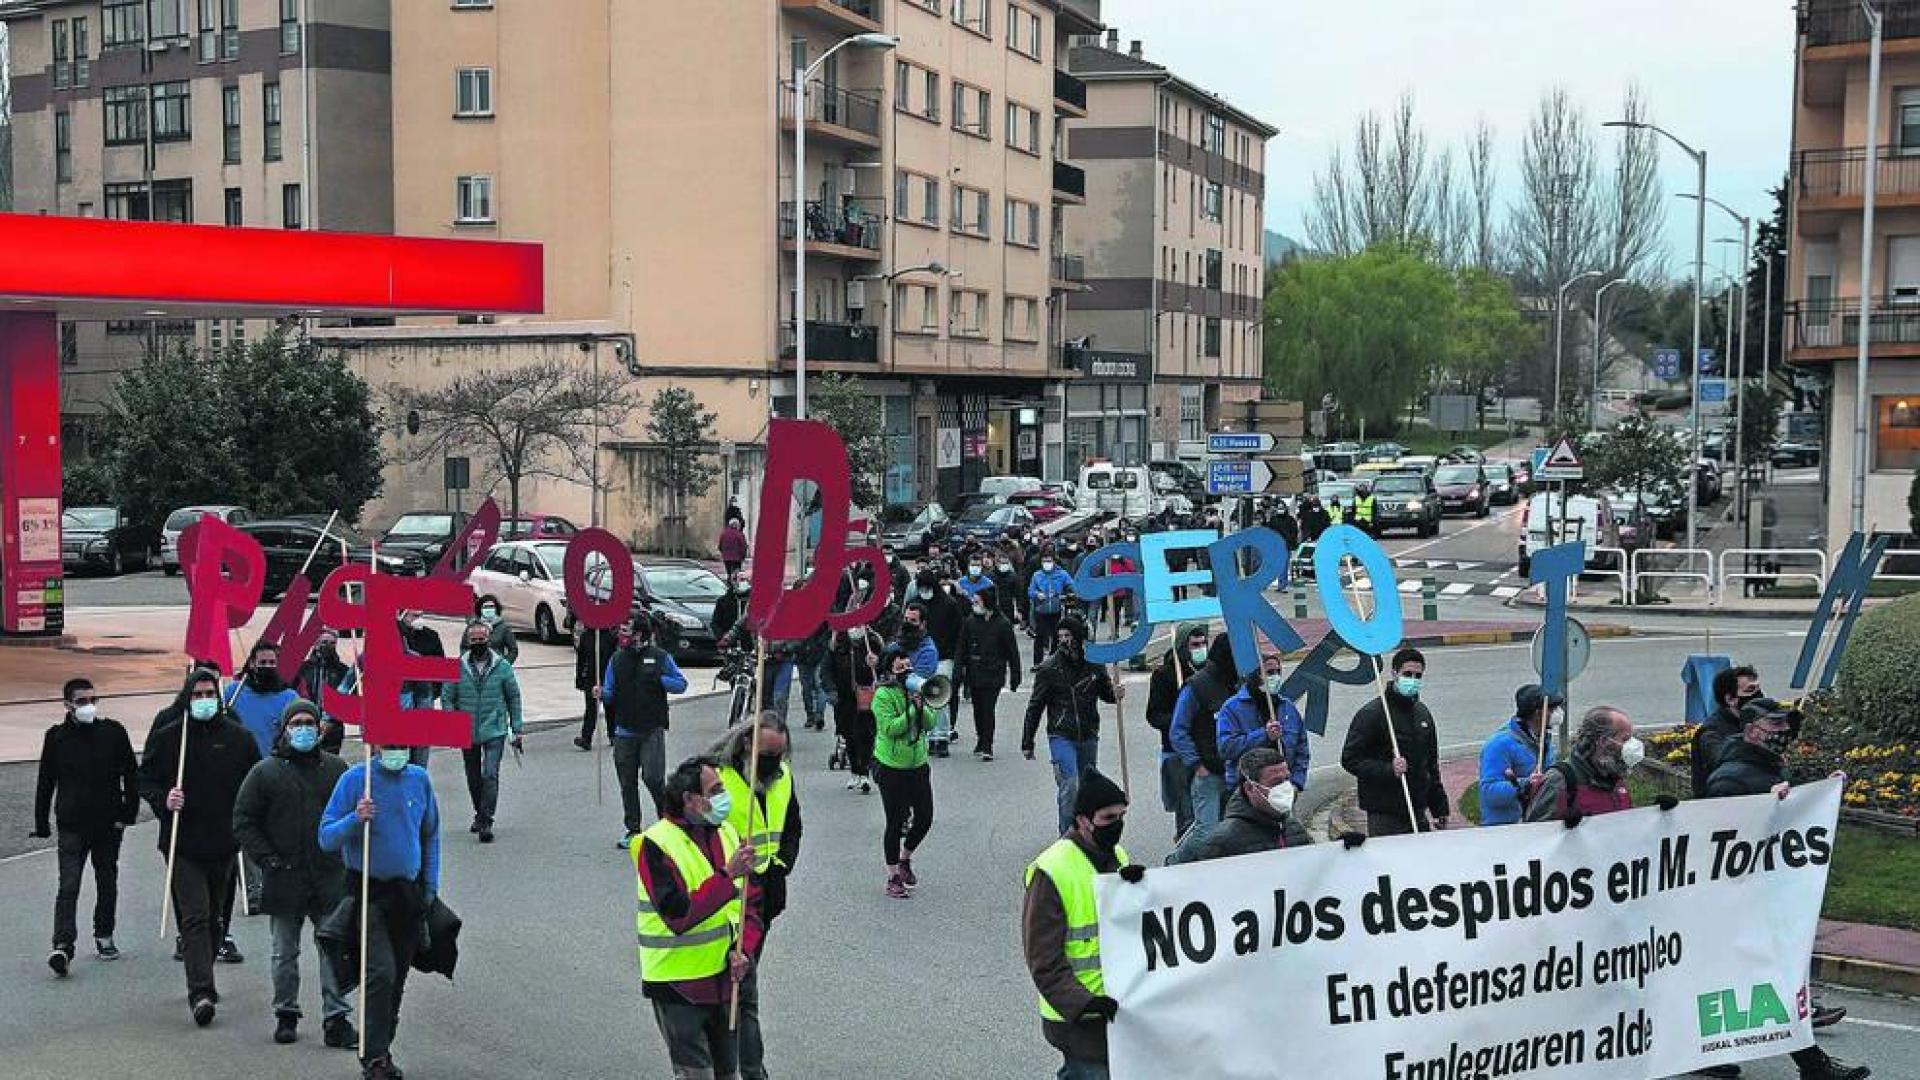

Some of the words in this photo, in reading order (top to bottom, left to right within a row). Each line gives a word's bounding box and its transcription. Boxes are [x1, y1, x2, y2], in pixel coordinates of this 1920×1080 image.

[1141, 900, 1217, 972] NO
[1231, 909, 1260, 956] a
[1271, 889, 1345, 949] los
[1361, 858, 1595, 940] despidos
[1607, 856, 1650, 904] en
[1657, 833, 1696, 892] M.
[1709, 825, 1830, 881] Torres
[1326, 972, 1377, 1025] En
[1386, 961, 1527, 1018] defensa
[1533, 940, 1583, 994] del
[1593, 924, 1683, 990] empleo
[1697, 982, 1791, 1038] ELA
